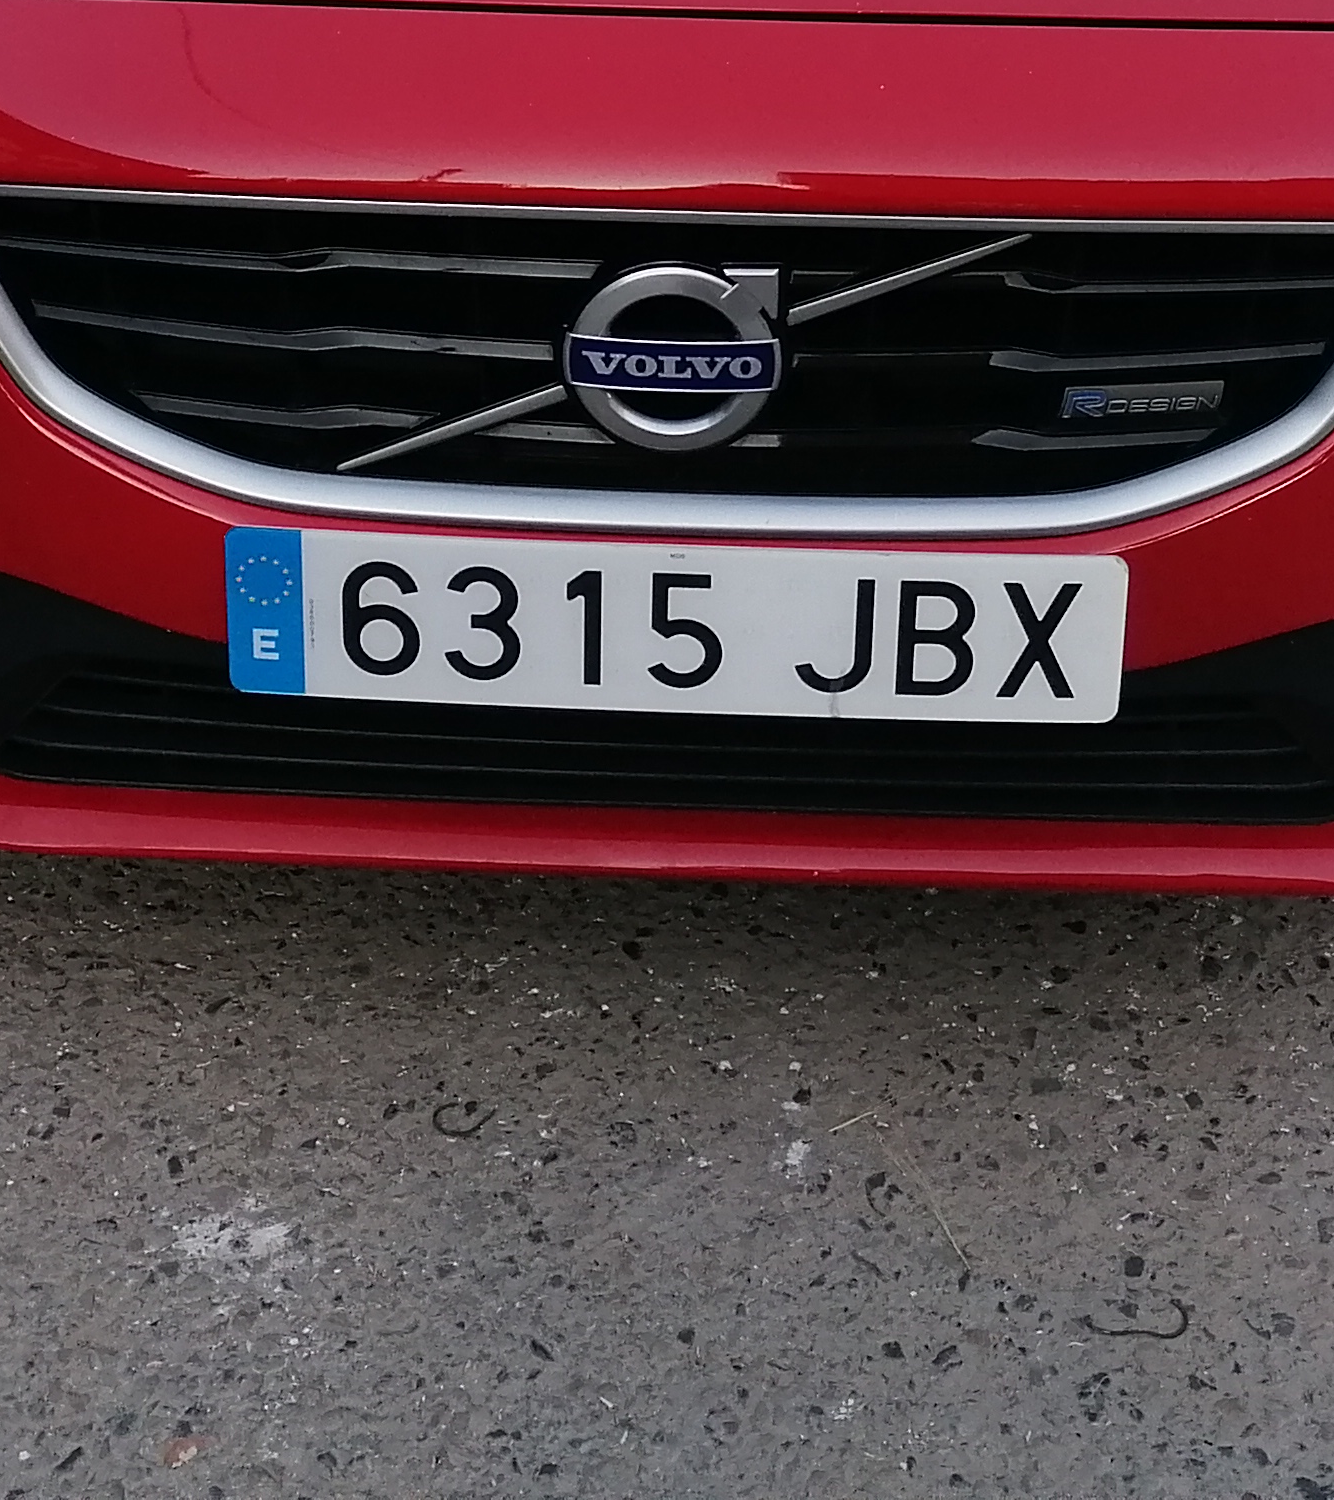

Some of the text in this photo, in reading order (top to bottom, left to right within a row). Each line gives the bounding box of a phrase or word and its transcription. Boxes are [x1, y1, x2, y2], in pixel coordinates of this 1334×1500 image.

[581, 350, 762, 379] VOLVO
[252, 628, 279, 660] E
[340, 560, 724, 689] 6315
[794, 577, 1083, 699] JBX
